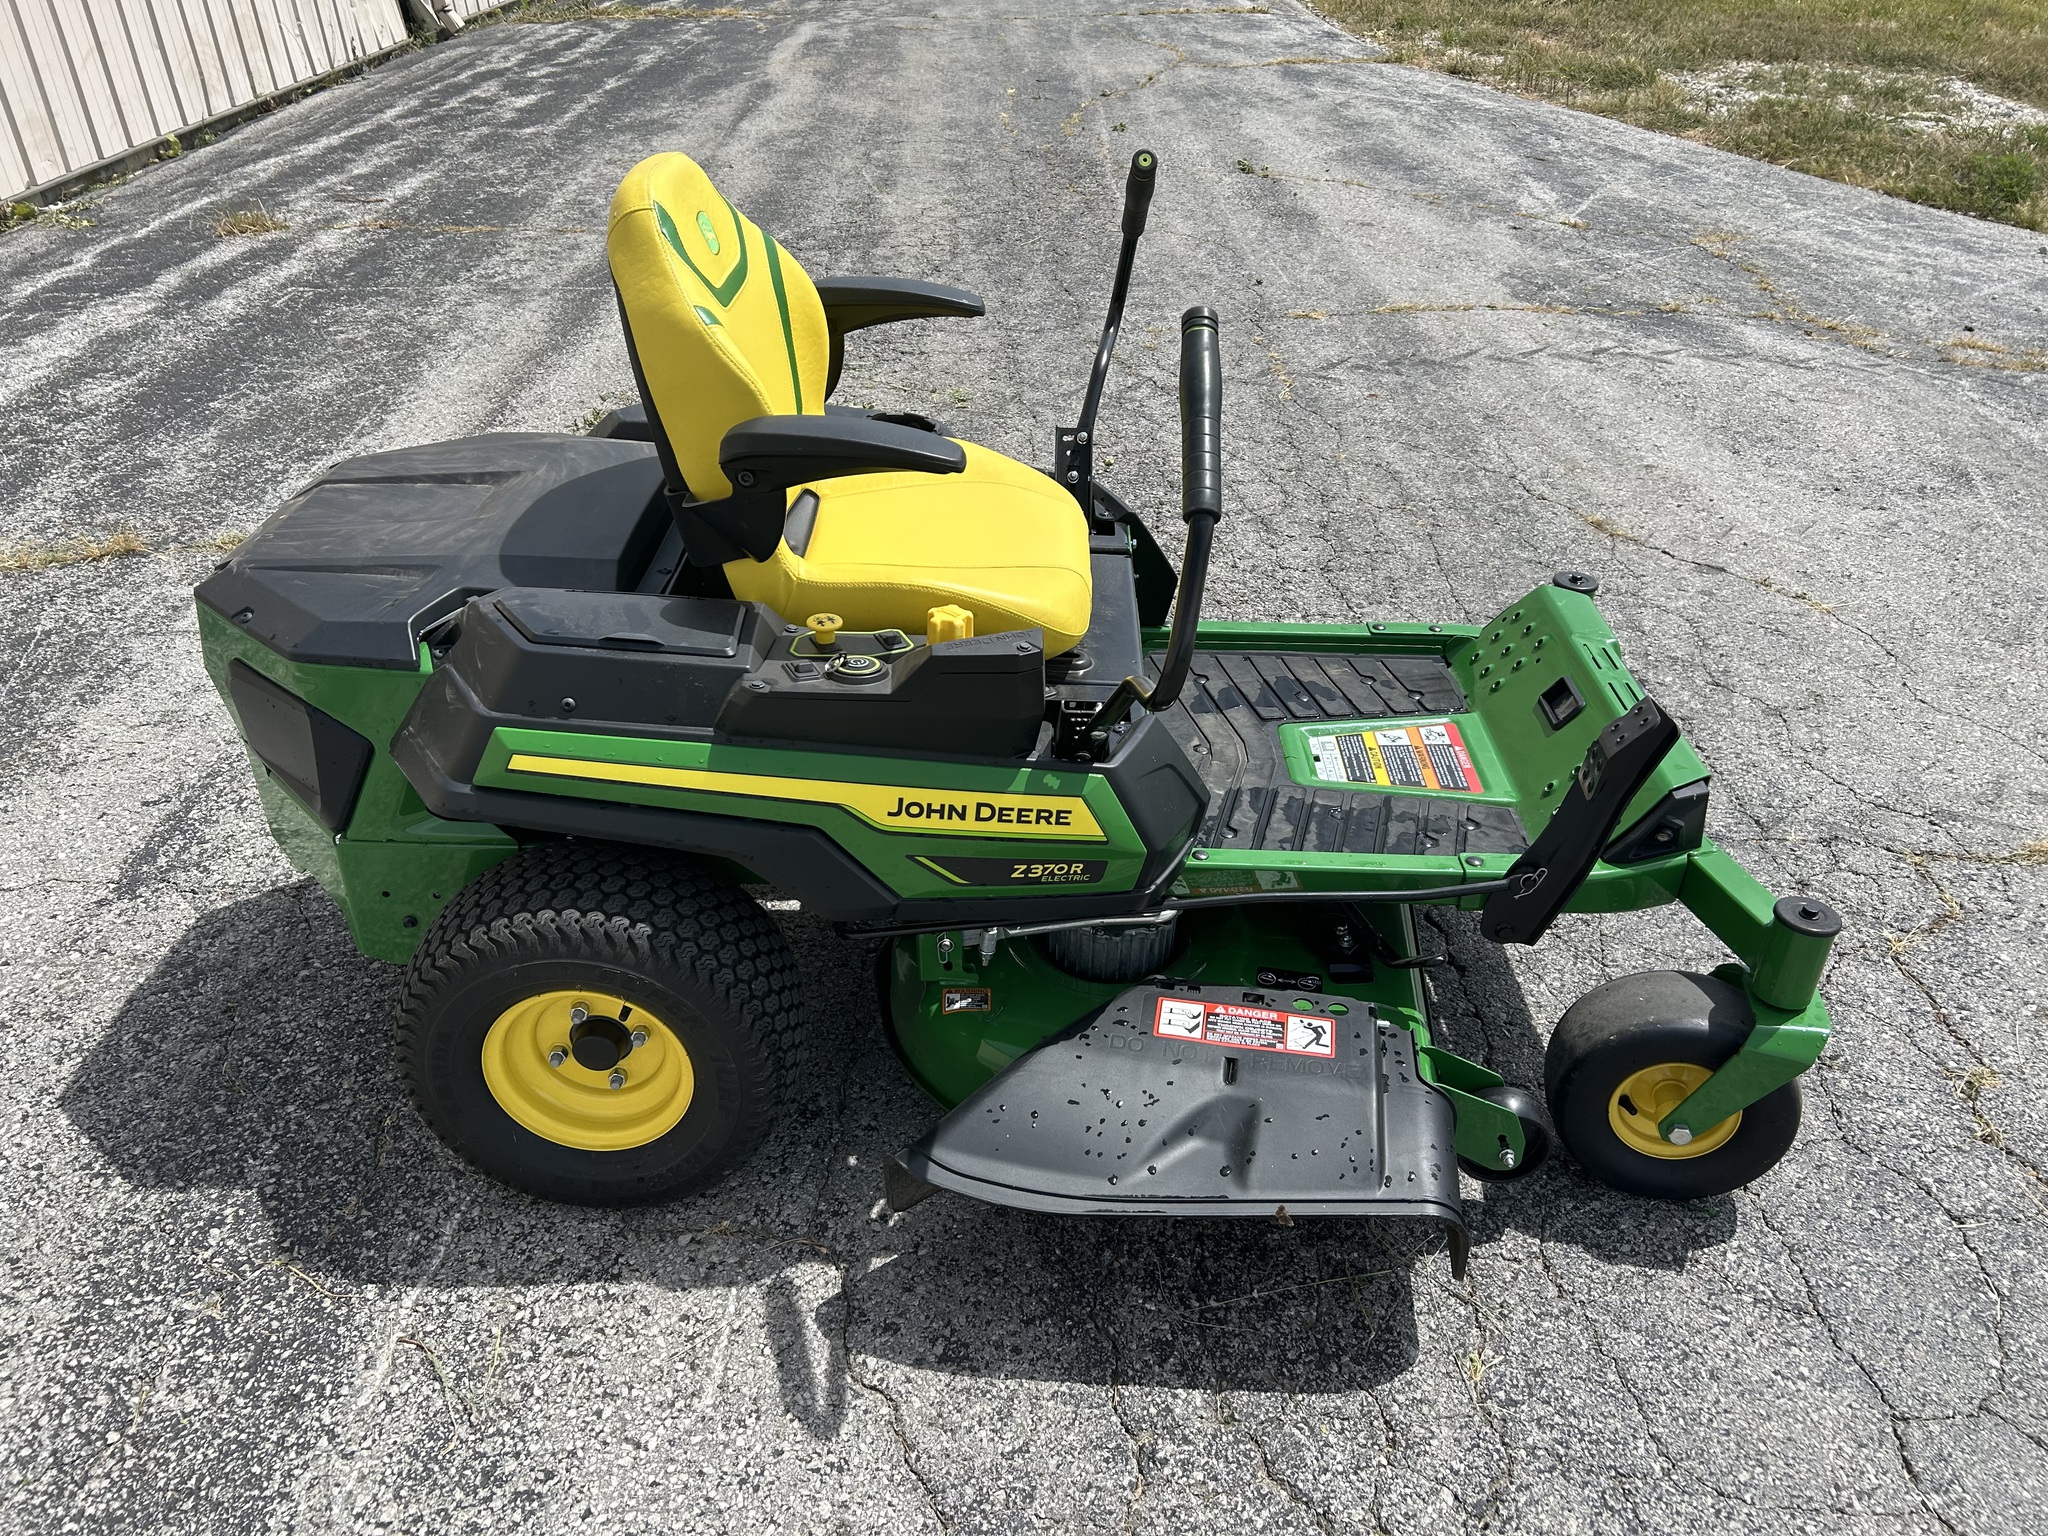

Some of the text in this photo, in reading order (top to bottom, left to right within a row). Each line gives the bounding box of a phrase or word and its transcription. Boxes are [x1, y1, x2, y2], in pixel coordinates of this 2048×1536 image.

[946, 630, 1034, 650] JOHN DEERE
[1369, 750, 1383, 770] CAUTION
[1416, 750, 1430, 770] WARNING
[1456, 750, 1472, 769] DANGER
[887, 797, 1072, 826] JOHN DEERE
[1041, 873, 1090, 883] ELECTRIC
[598, 967, 708, 1032] SUPER
[1228, 1007, 1278, 1020] DANGER
[1109, 1034, 1361, 1079] DO NOT REMOVE
